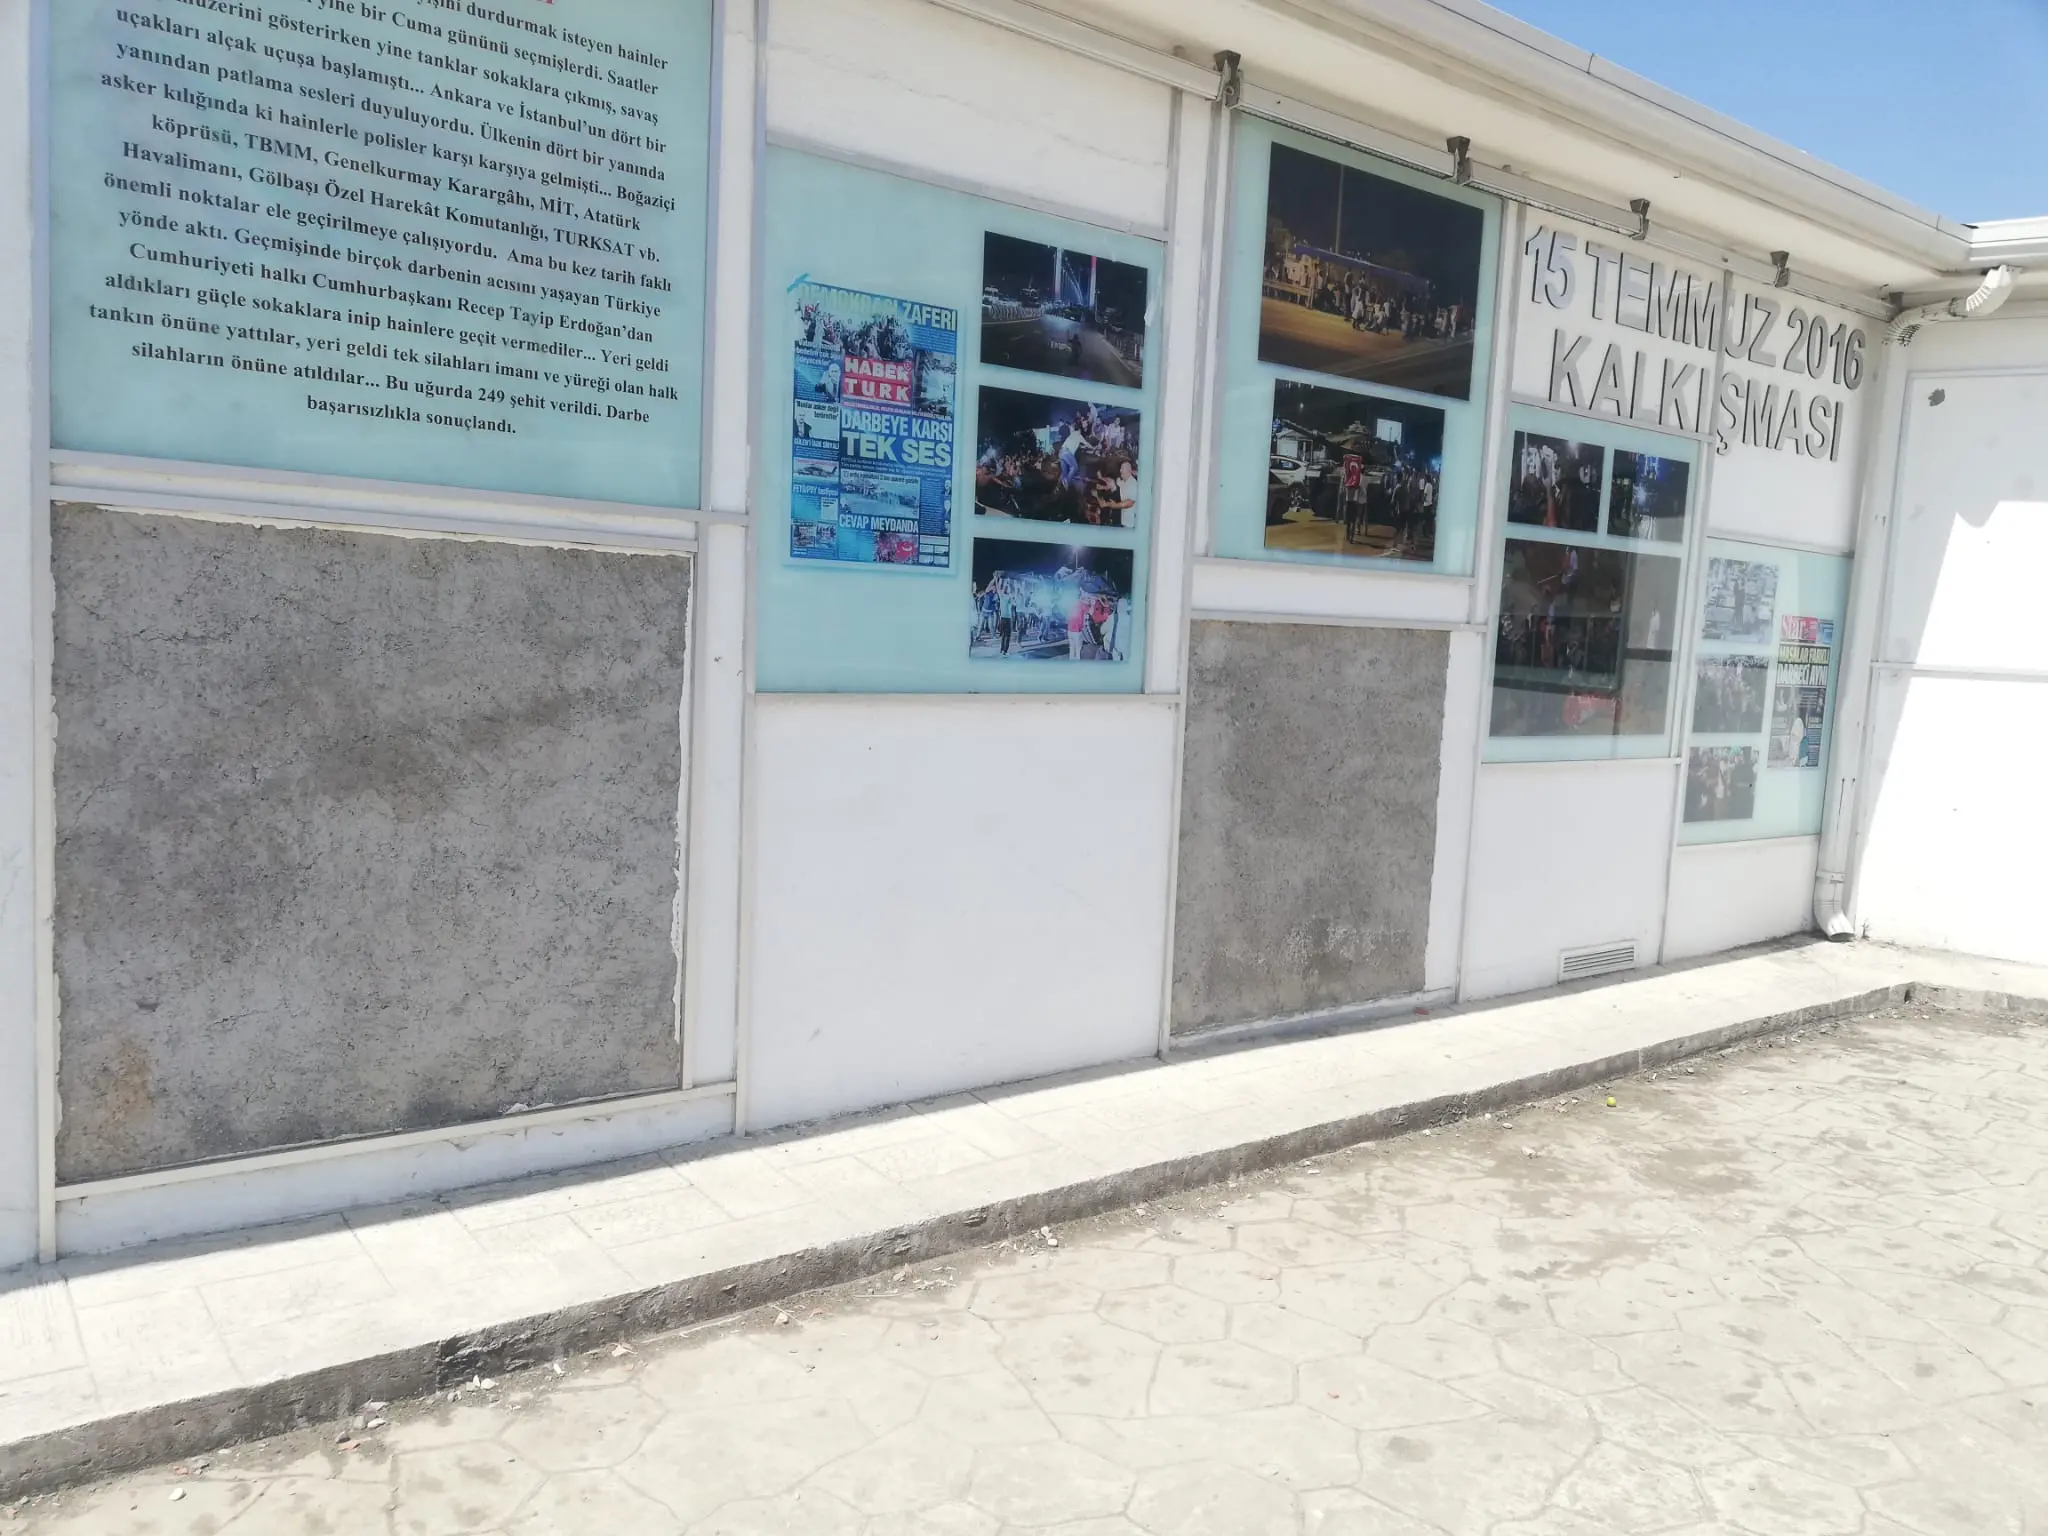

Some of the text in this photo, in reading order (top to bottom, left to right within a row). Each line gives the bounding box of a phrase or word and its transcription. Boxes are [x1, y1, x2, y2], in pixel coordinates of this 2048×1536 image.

[116, 9, 200, 40] uçakları
[206, 30, 257, 53] alçak
[264, 45, 315, 68] uçuşa
[321, 54, 424, 94] başlamıştı...
[429, 83, 492, 110] Ankara
[497, 102, 514, 116] ve
[611, 128, 642, 148] dört
[646, 136, 667, 153] bir
[268, 13, 371, 50] gösterirken
[376, 40, 412, 60] yine
[417, 50, 478, 76] tanklar
[483, 69, 559, 98] sokaklara
[564, 90, 616, 116] çıkmış,
[621, 105, 658, 127] savaş
[361, 2, 387, 22] bir
[392, 11, 442, 38] Cuma
[448, 29, 508, 55] gününü
[514, 47, 603, 81] seçmişlerdi.
[607, 70, 659, 95] Saatler
[466, 1, 558, 40] durdurmak
[562, 28, 612, 55] isteyen
[618, 44, 668, 70] hainler
[101, 74, 675, 213] asker kılığında ki hainlerle polisler karşı karşıya gelmişti... Boğaziçi
[116, 43, 665, 181] yanından patlama sesleri duyuluyordu. Ülkenin dört bir yanında
[122, 141, 660, 263] Havalimanı, Gölbaşı Özel Harekât Komutanlığı, TURKSAT vb.
[152, 114, 640, 231] köprüsü, TBMM, Genelkurmay Karargâhı, MİT, Atatürk
[104, 172, 671, 292] önemli noktalar ele geçirilmeye çalışıyordu. Ama bu kez tarih faklı
[119, 210, 661, 319] yönde aktı. Geçmişinde birçok darbenin acısını yaşayan Türkiye
[105, 273, 669, 372] aldıkları güçle sokaklara inip hainlere geçit vermediler... Yeri geldi
[129, 243, 254, 277] Cumhuriyeti
[261, 264, 306, 285] halkı
[312, 273, 452, 309] Cumhurbaşkanı
[457, 297, 505, 321] Recep
[509, 306, 554, 329] Tayip
[1525, 225, 1866, 391] 15 TEMMUZ 2016
[89, 304, 678, 401] tankın önüne yattılar, yeri geldi tek silahları imanı ve yüreği olan halk
[132, 342, 650, 423] silahların önüne atıldılar... Bu uğurda 249 şehit verildi. Darbe
[1548, 329, 1844, 462] KALKIŞMASI
[307, 394, 516, 434] başarısızlıkla sonuçlandı.
[842, 408, 908, 436] DARBEYE
[842, 431, 898, 461] TEK
[902, 439, 952, 466] SES
[839, 514, 919, 533] CEVAP MEYDANDA
